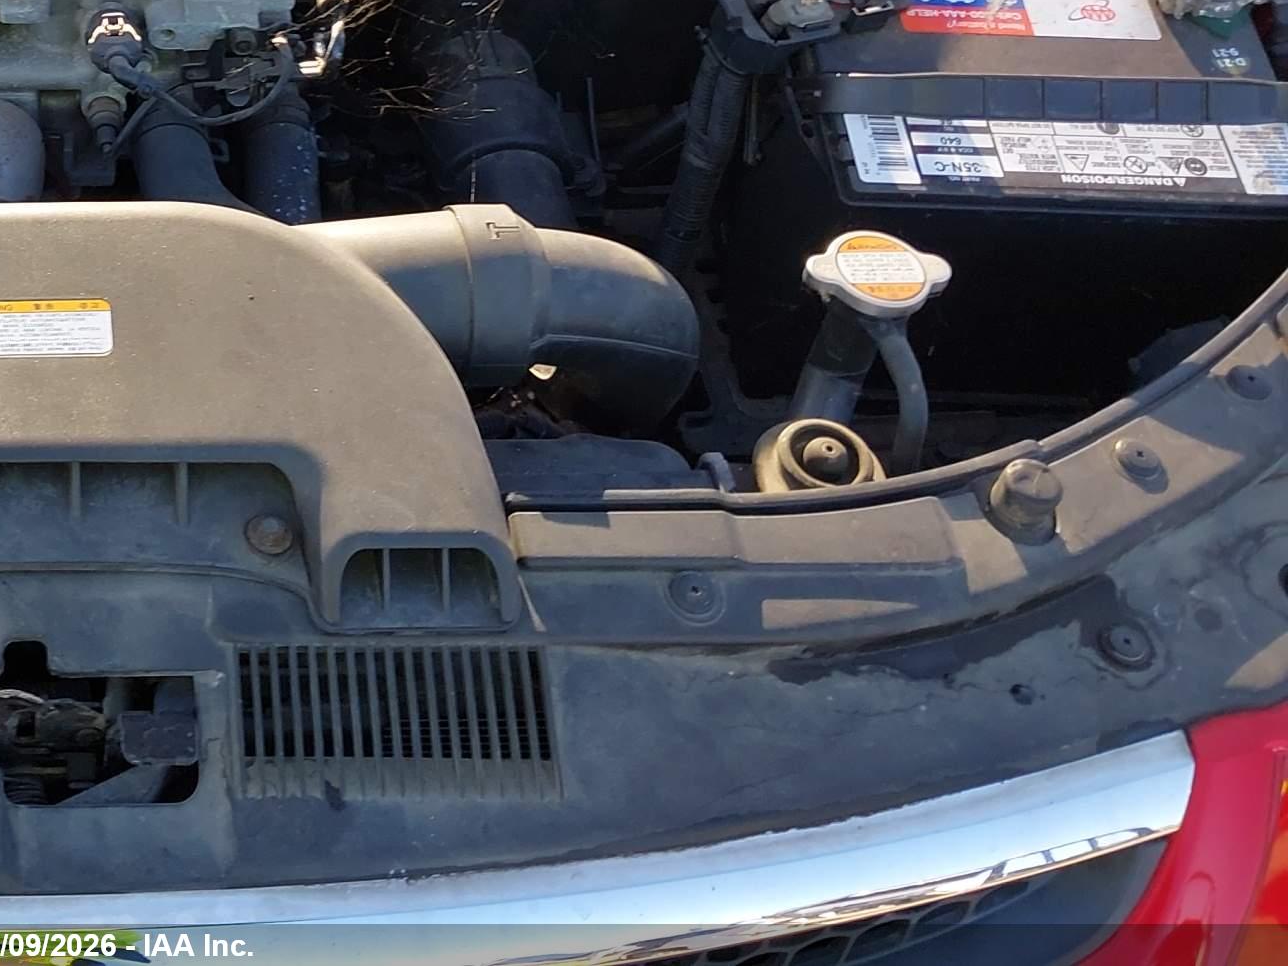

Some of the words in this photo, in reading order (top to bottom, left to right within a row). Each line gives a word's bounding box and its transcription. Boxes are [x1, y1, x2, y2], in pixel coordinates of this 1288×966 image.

[1216, 57, 1247, 68] D-21
[940, 137, 962, 146] 640
[1060, 173, 1174, 186] DANGER/POISON
